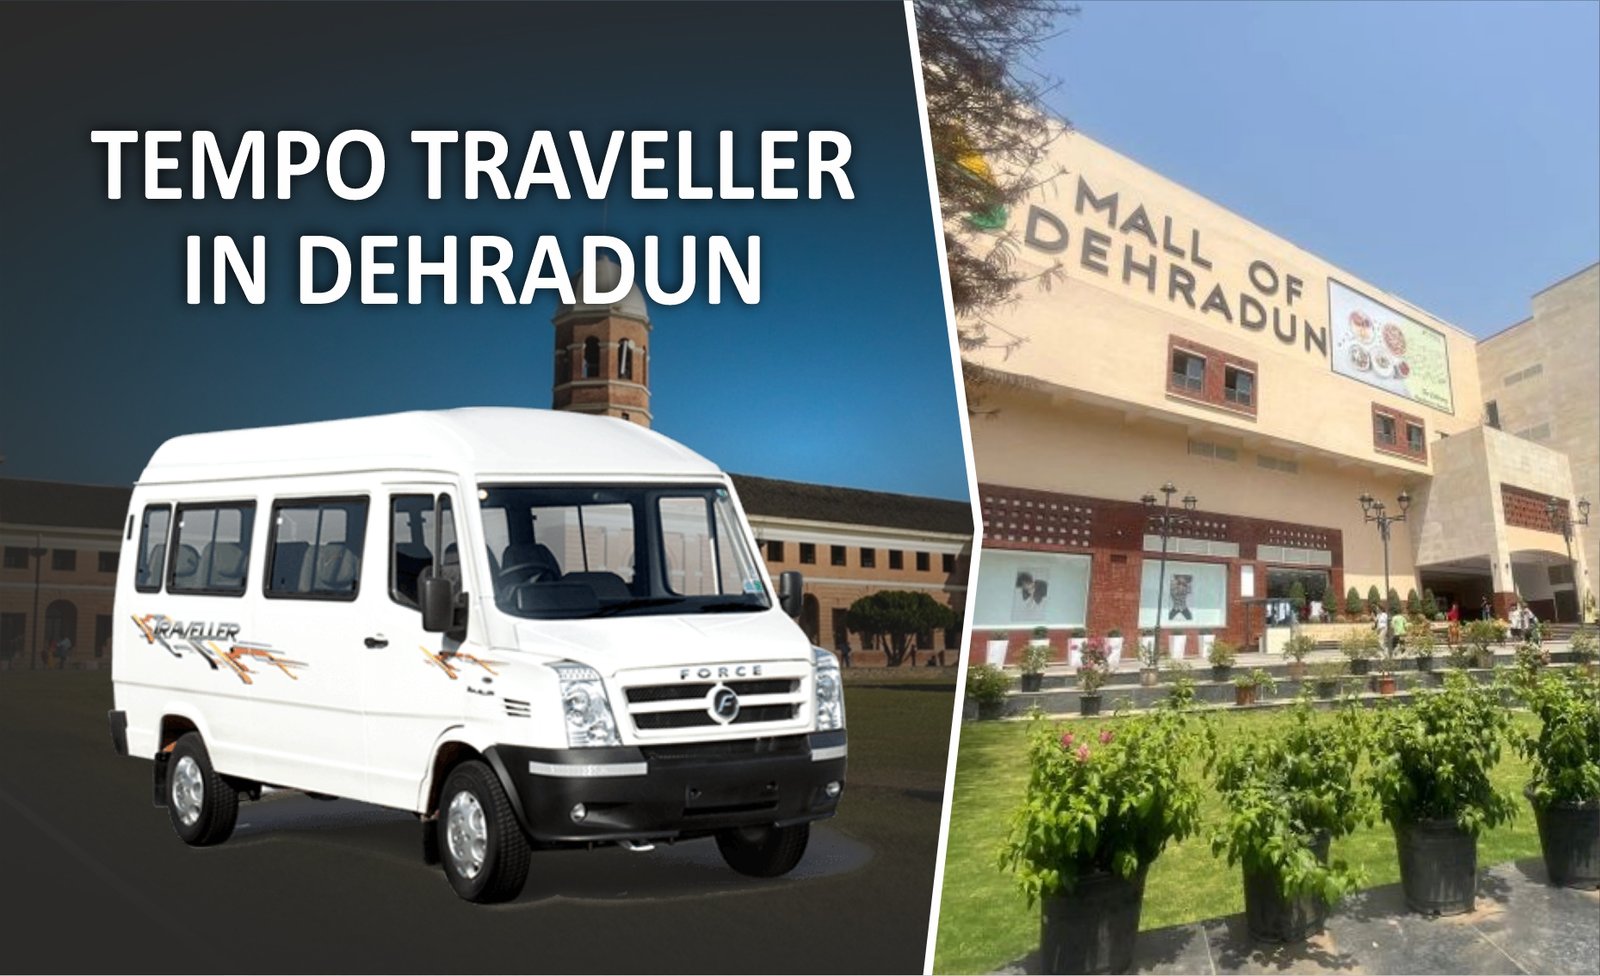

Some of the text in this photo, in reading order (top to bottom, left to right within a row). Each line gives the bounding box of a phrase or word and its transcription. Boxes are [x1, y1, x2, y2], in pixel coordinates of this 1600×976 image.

[1024, 205, 1327, 357] DEHRADUN
[1075, 174, 1304, 306] MALL OF
[680, 665, 762, 679] FORCE
